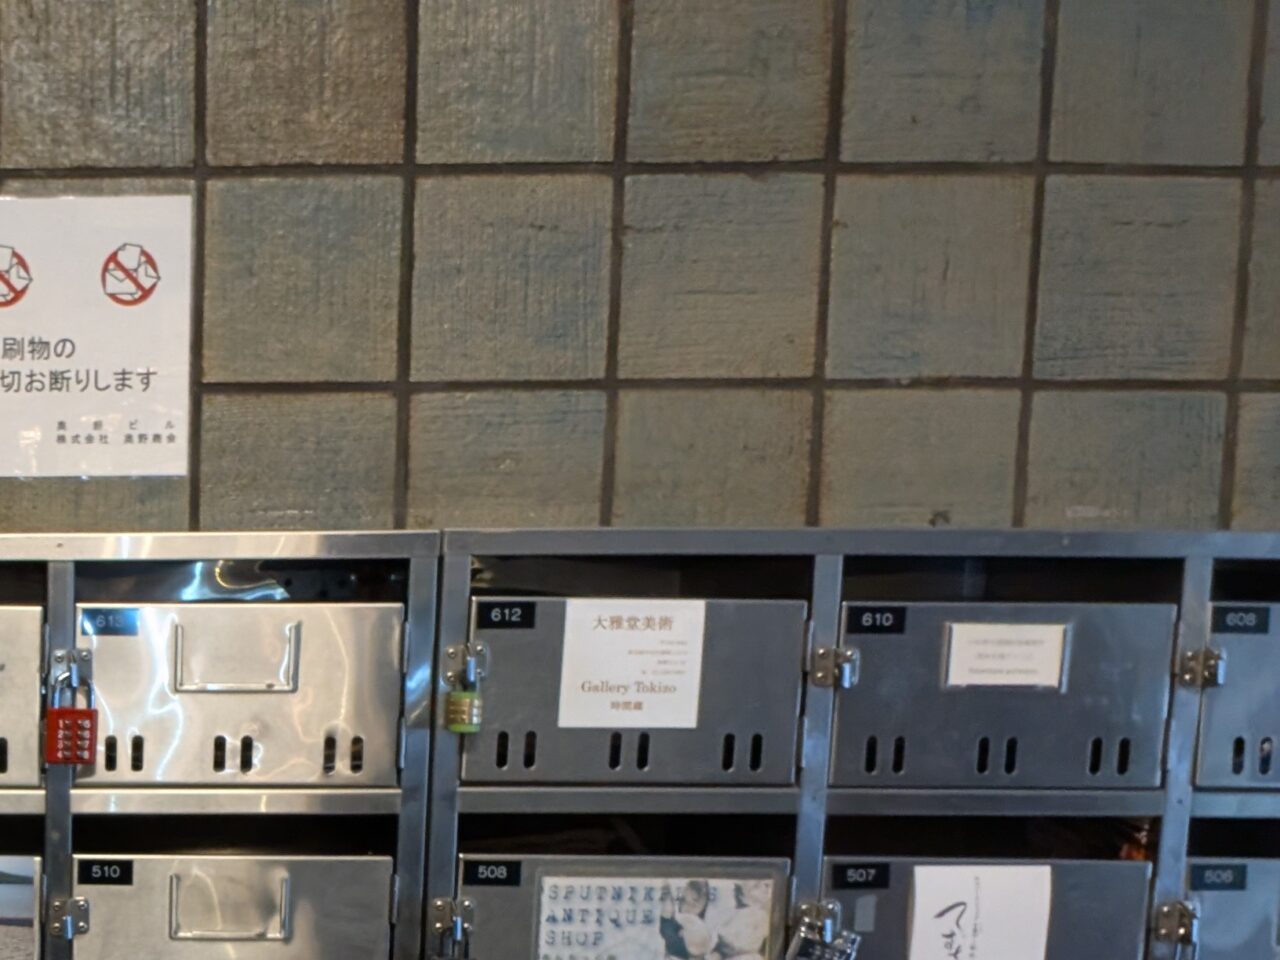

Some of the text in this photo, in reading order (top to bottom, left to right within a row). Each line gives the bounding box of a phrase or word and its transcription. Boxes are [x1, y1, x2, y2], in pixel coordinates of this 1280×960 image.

[490, 607, 522, 622] 612
[861, 612, 894, 627] 610
[580, 681, 677, 696] Gallery Tokizo
[91, 865, 121, 878] 510
[477, 865, 508, 880] 508
[846, 868, 876, 883] 507
[548, 884, 718, 901] SPUTNIKPLS
[545, 908, 655, 928] ANTIQUE
[544, 930, 604, 947] SHOP
